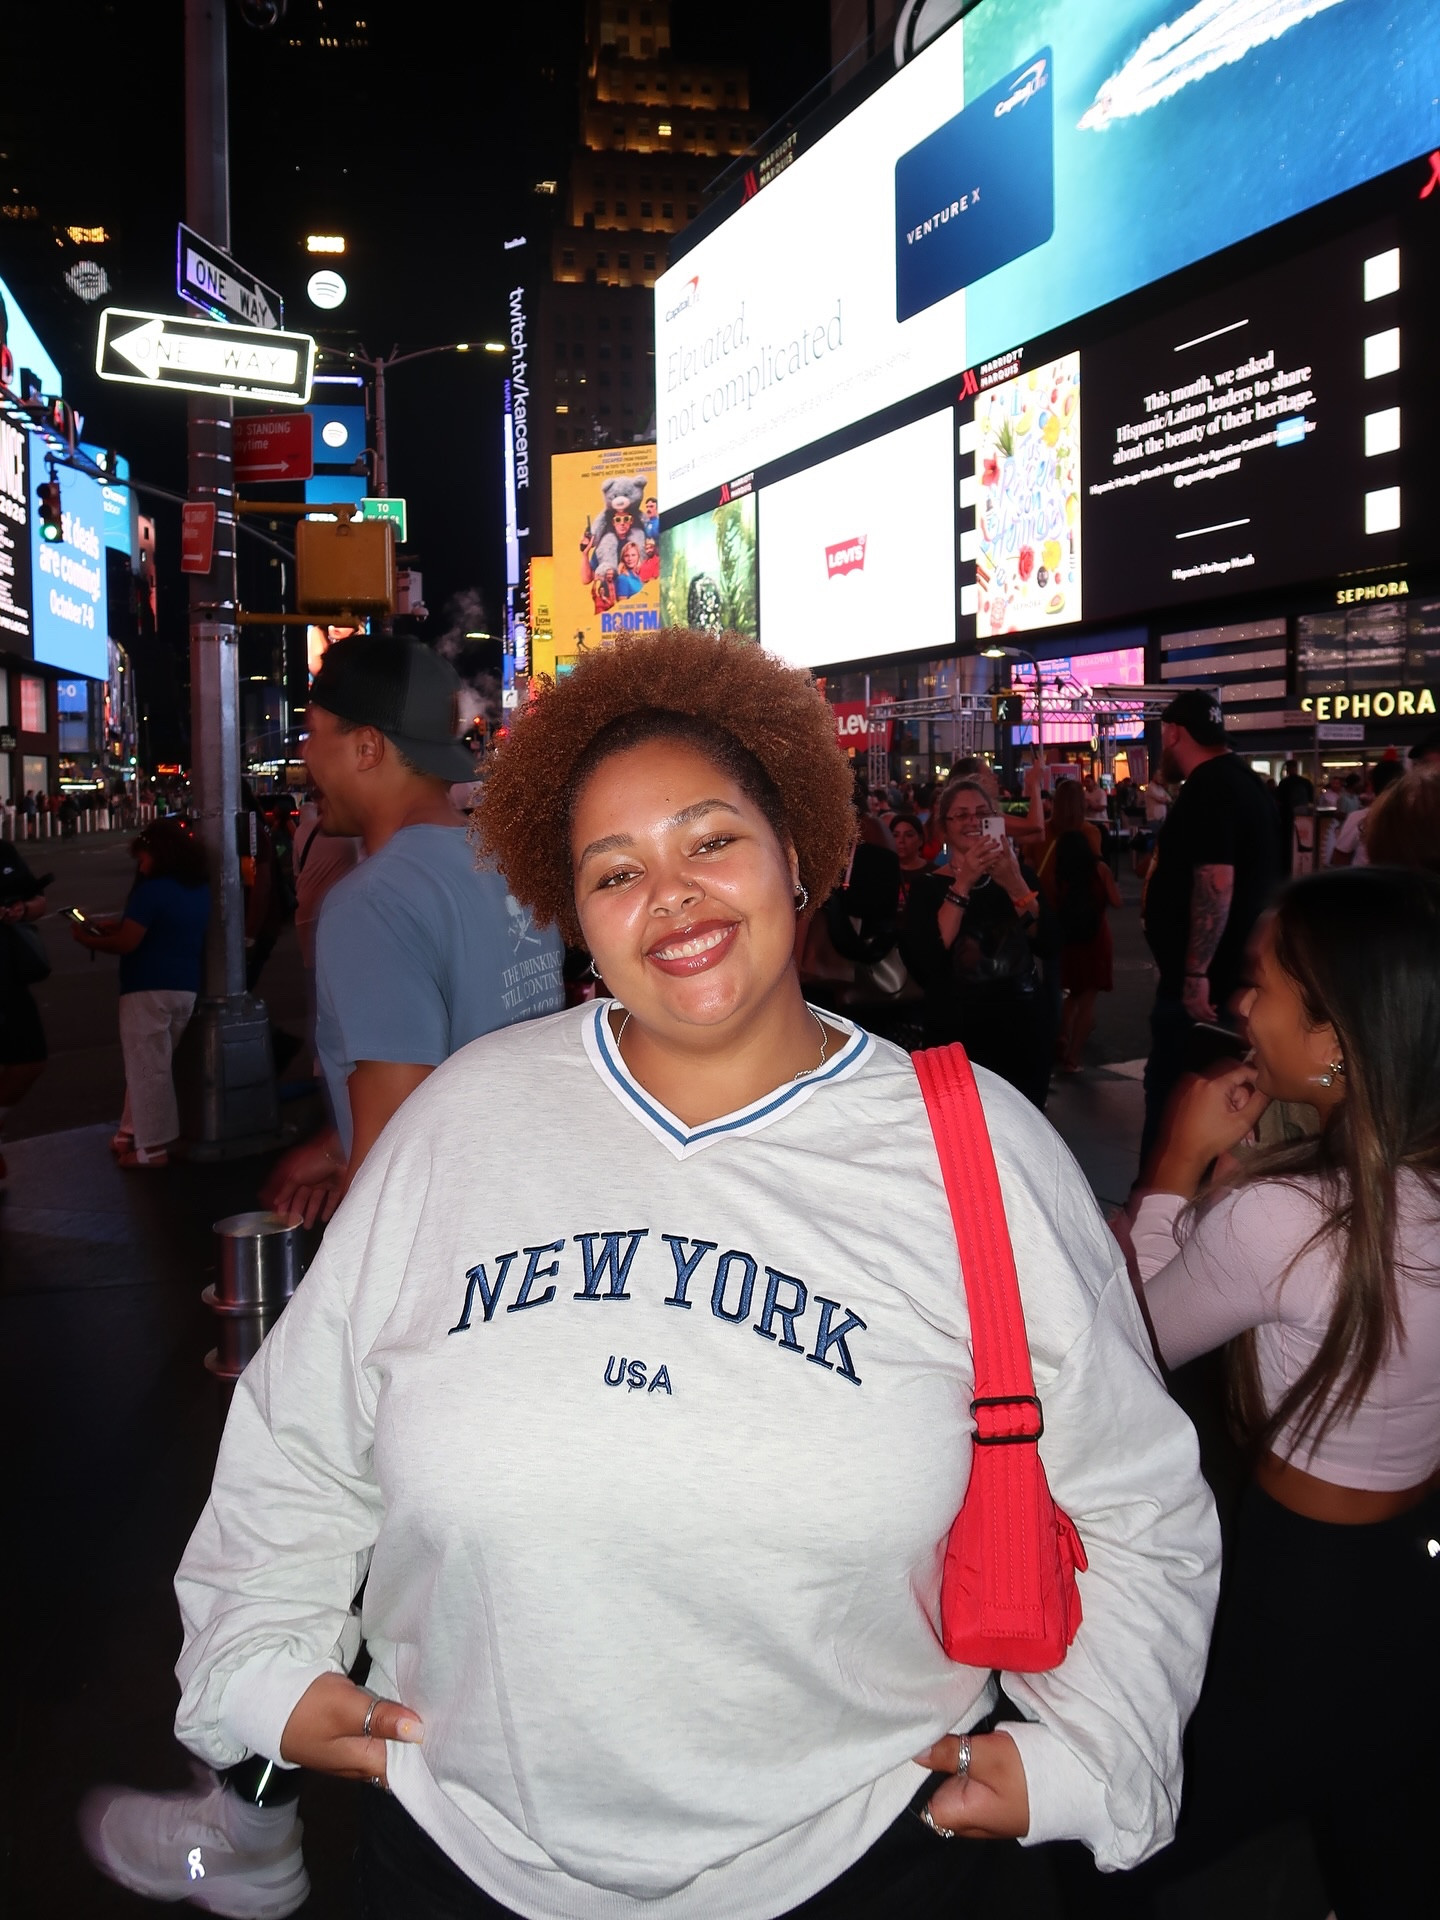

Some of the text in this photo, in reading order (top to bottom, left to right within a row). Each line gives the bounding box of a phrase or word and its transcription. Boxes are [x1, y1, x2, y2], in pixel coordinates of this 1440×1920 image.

[759, 131, 798, 172] MARRIOTT
[759, 151, 794, 188] MARQUIS
[906, 186, 981, 245] VENTURE X
[196, 260, 268, 328] ONE WAY
[135, 335, 281, 375] ONE WAY
[667, 399, 696, 445] not
[702, 298, 844, 412] complicated
[980, 347, 1024, 375] MARRIOTT
[508, 286, 530, 489] twitch.tv/kaicenat
[980, 362, 1019, 388] MARQUIS
[1144, 350, 1274, 412] This month, we asked
[1117, 366, 1312, 442] Hispanic/Latino leaders to share
[246, 421, 291, 436] STANDING
[1113, 390, 1317, 465] about the beauty of their heritage.
[1089, 481, 1115, 495] Hispanic
[1141, 466, 1163, 481] Month
[377, 503, 389, 513] TO
[73, 516, 100, 560] deals
[40, 544, 60, 578] are
[61, 554, 101, 603] coming!
[1231, 554, 1255, 568] Month
[50, 589, 82, 625] October
[1336, 580, 1410, 605] SEPHORA
[601, 610, 660, 633] ROOFM
[1301, 688, 1437, 721] SEPHORA
[502, 964, 521, 988] THE
[501, 986, 523, 1010] WILL
[448, 1228, 868, 1386] NEW YORK
[603, 1355, 673, 1396] USA
